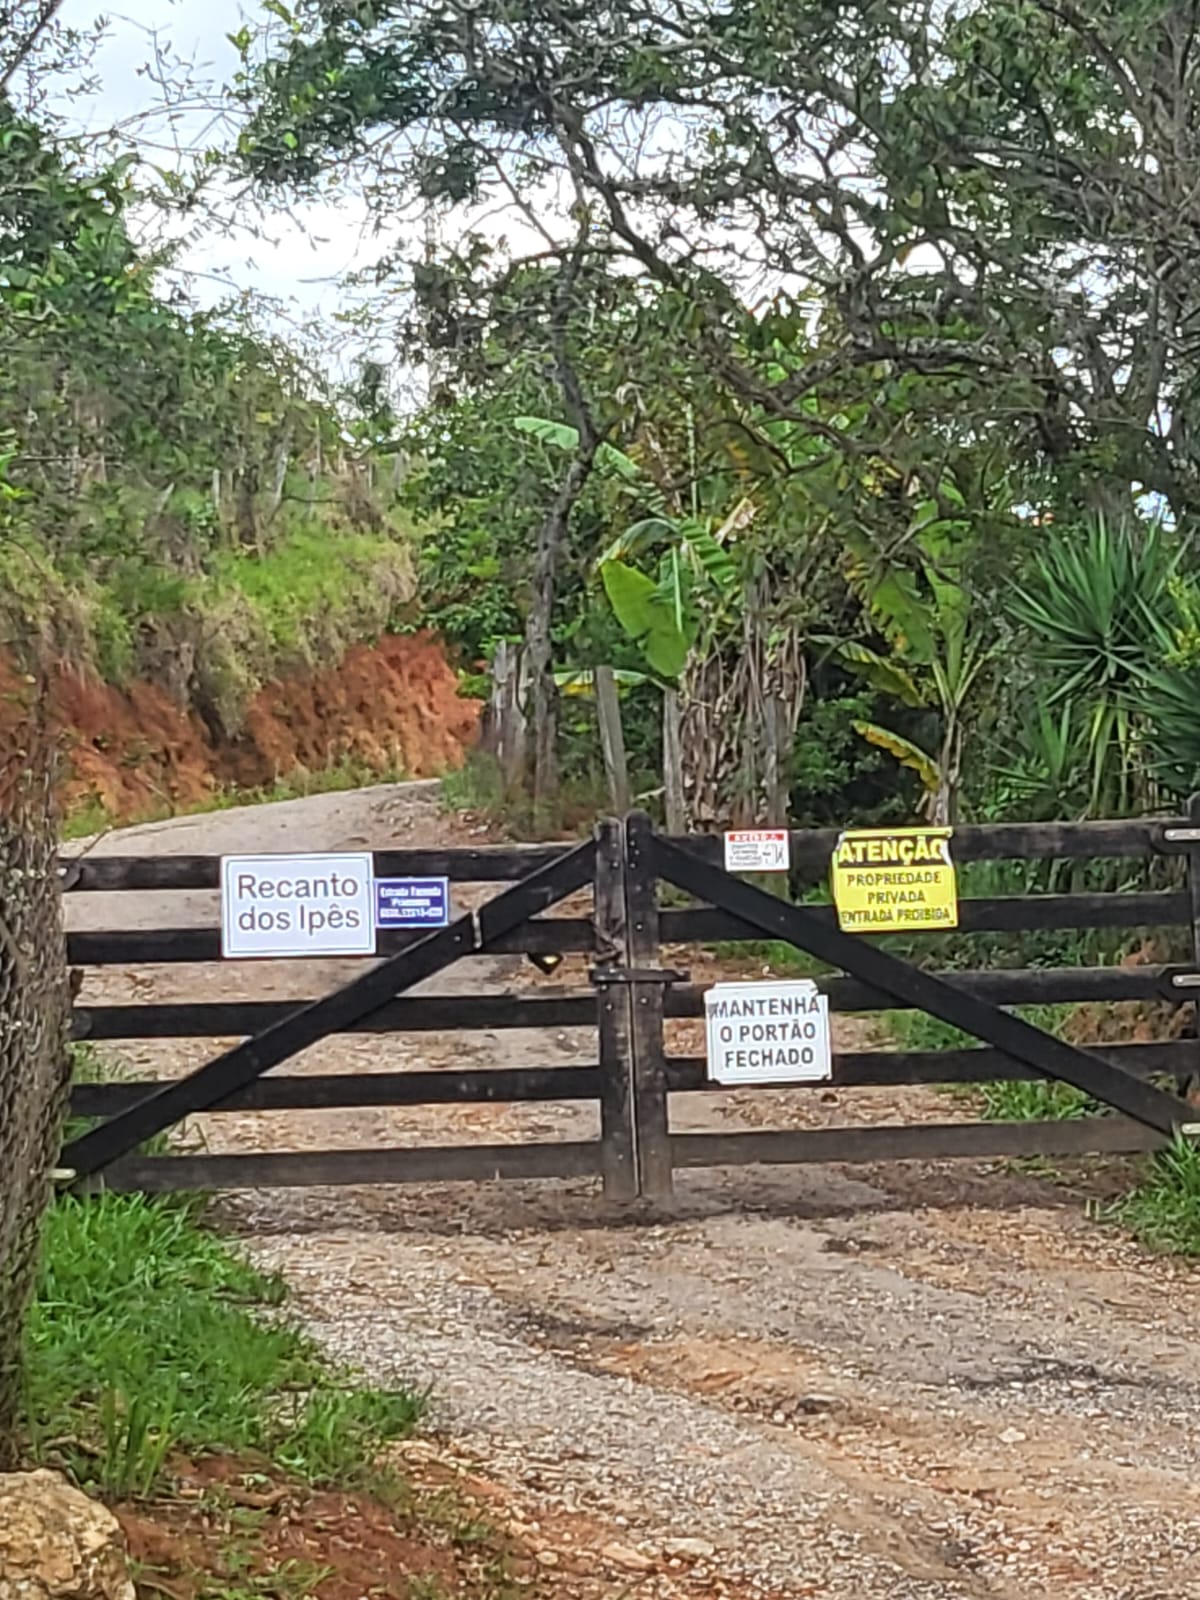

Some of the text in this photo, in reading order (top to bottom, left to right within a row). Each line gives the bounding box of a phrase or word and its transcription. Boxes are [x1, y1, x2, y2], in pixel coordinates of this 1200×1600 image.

[838, 836, 943, 865] ATENÇÃO
[238, 873, 358, 899] Recanto
[847, 872, 942, 886] PROPRIEDADE
[867, 890, 926, 904] PRIVADA
[239, 903, 360, 936] dos Ipês
[841, 909, 893, 924] ENTRADA
[708, 997, 820, 1018] MANTENHA
[720, 1019, 816, 1042] O PORTÃO
[725, 1047, 814, 1068] FECHADO
